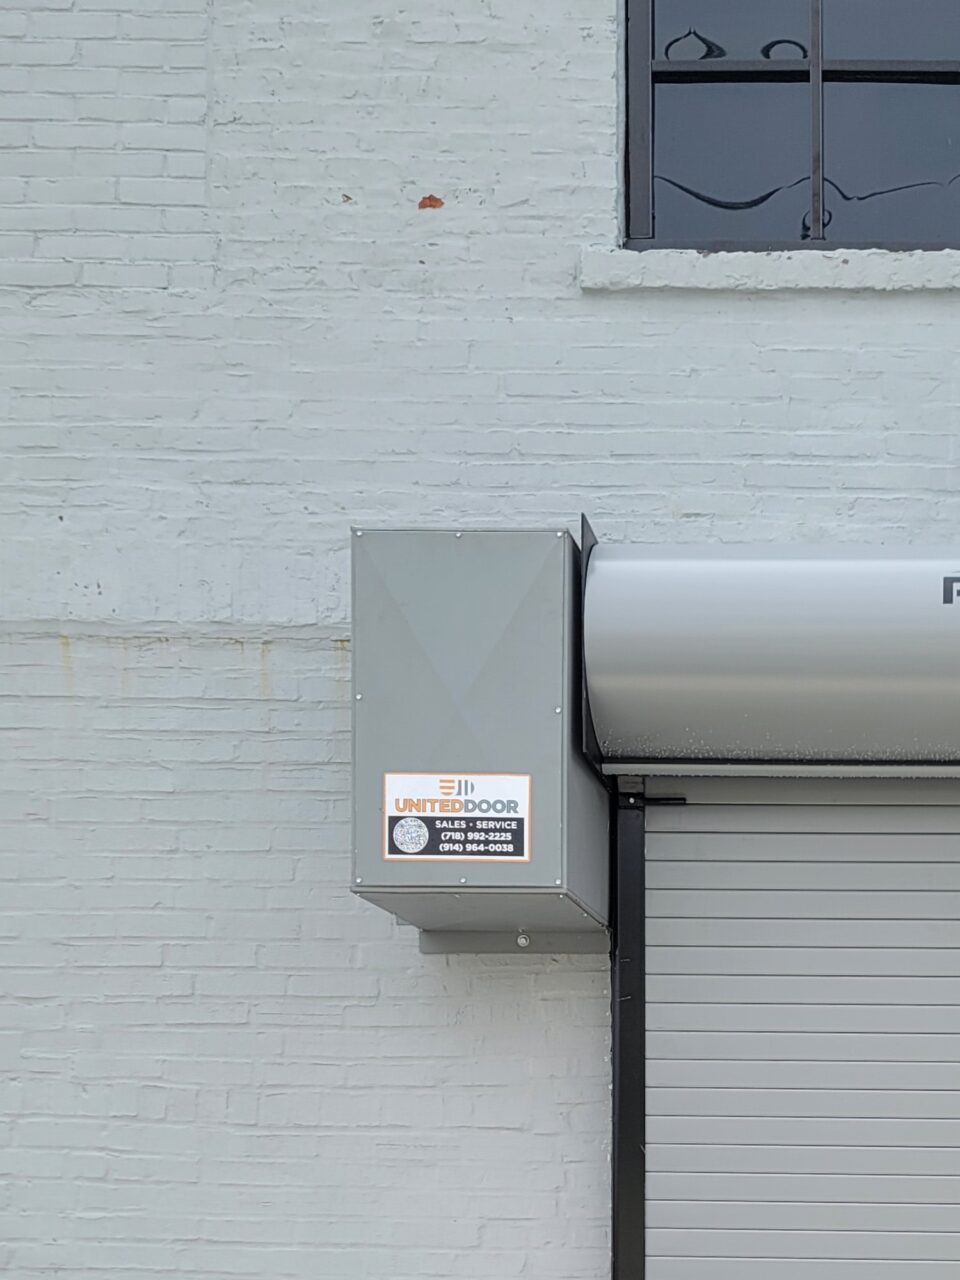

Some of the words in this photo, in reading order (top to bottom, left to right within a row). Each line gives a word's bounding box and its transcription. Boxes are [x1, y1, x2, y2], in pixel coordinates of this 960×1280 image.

[435, 820, 467, 829] SALES
[475, 820, 518, 829] SERVICE
[441, 831, 465, 841] (718)
[467, 832, 512, 841] 992-2225
[439, 842, 464, 852] (914)
[465, 843, 514, 852] 964-0038
